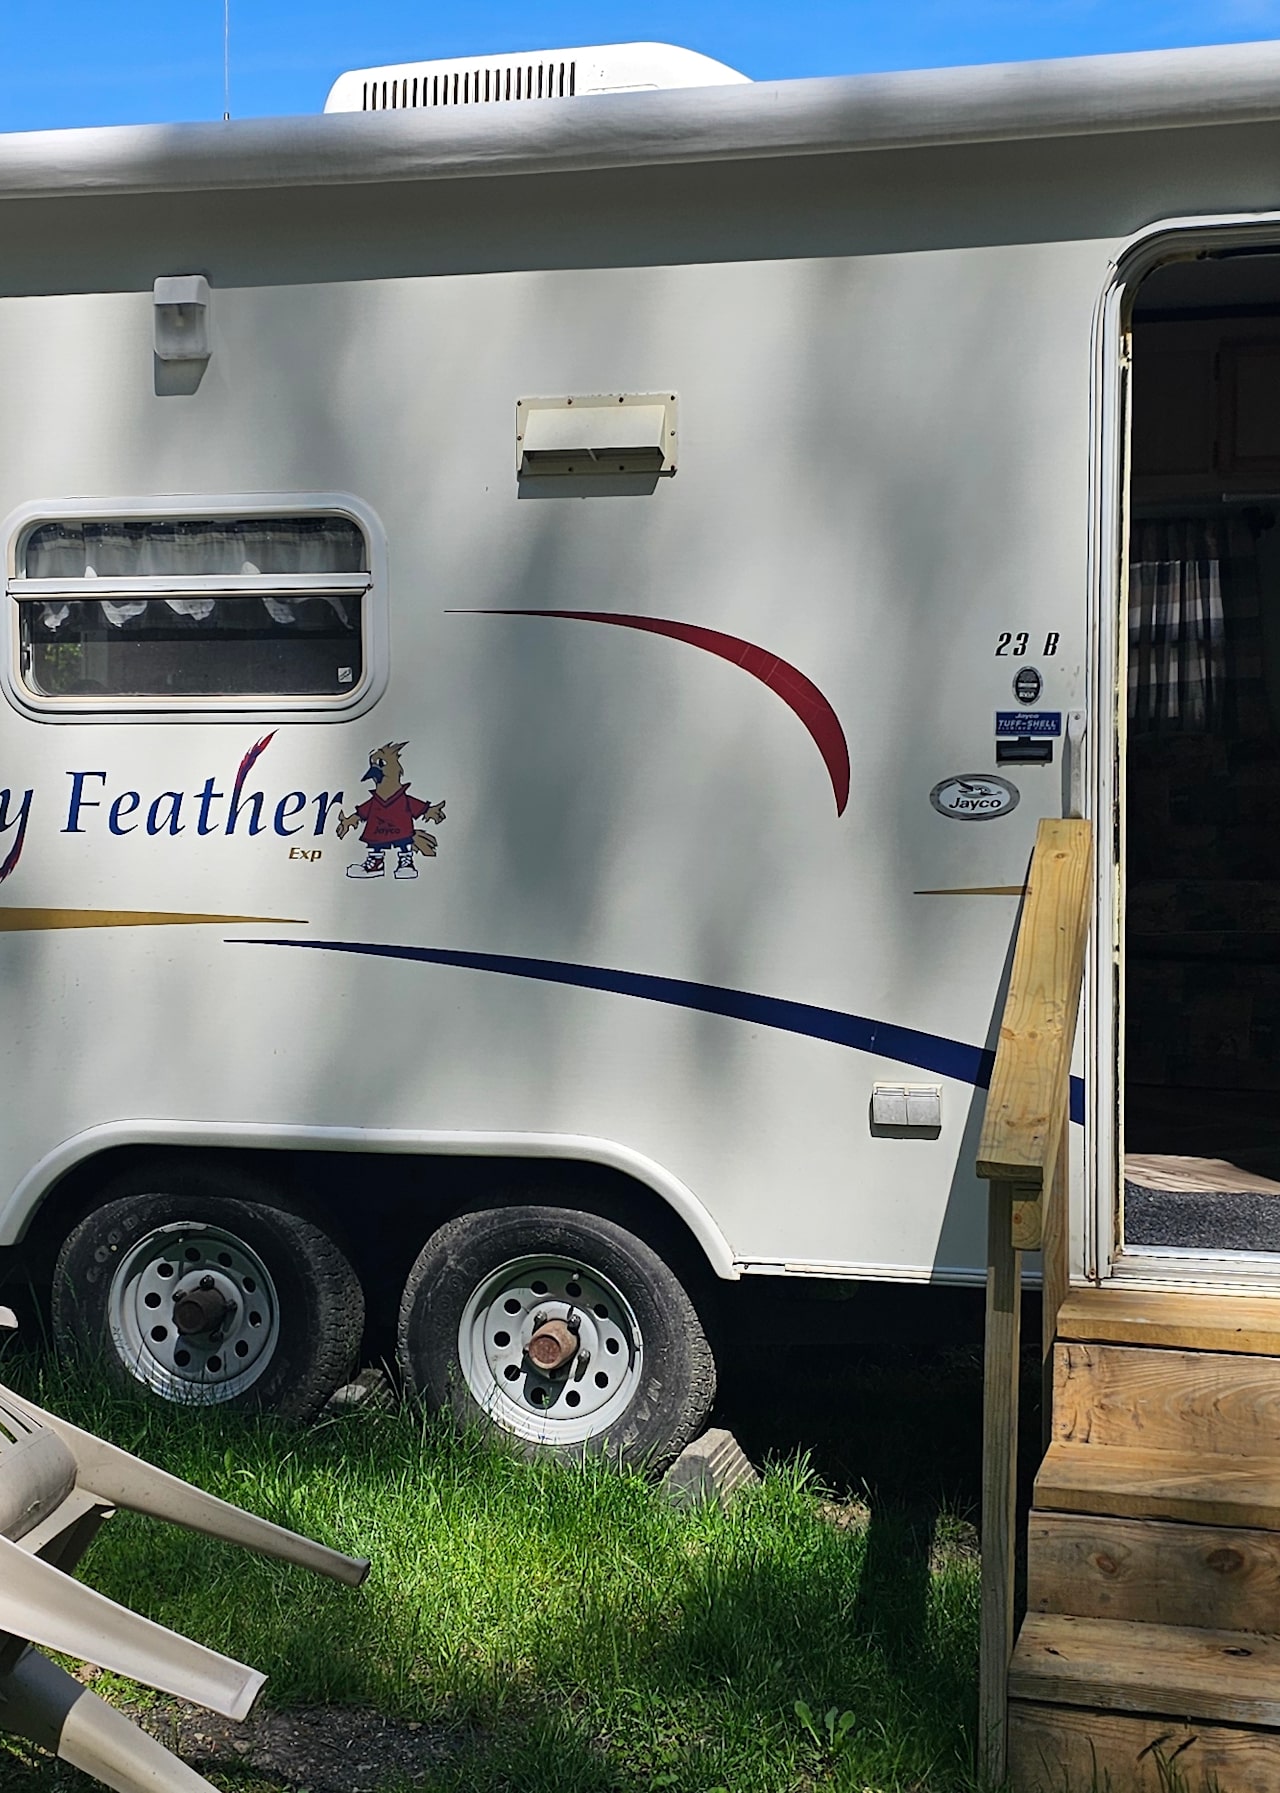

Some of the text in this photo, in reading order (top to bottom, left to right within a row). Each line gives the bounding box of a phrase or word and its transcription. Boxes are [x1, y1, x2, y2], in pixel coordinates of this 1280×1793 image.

[995, 632, 1060, 656] 23 B
[60, 727, 345, 838] Feather
[948, 797, 1002, 810] Jayco
[288, 846, 322, 862] Exp
